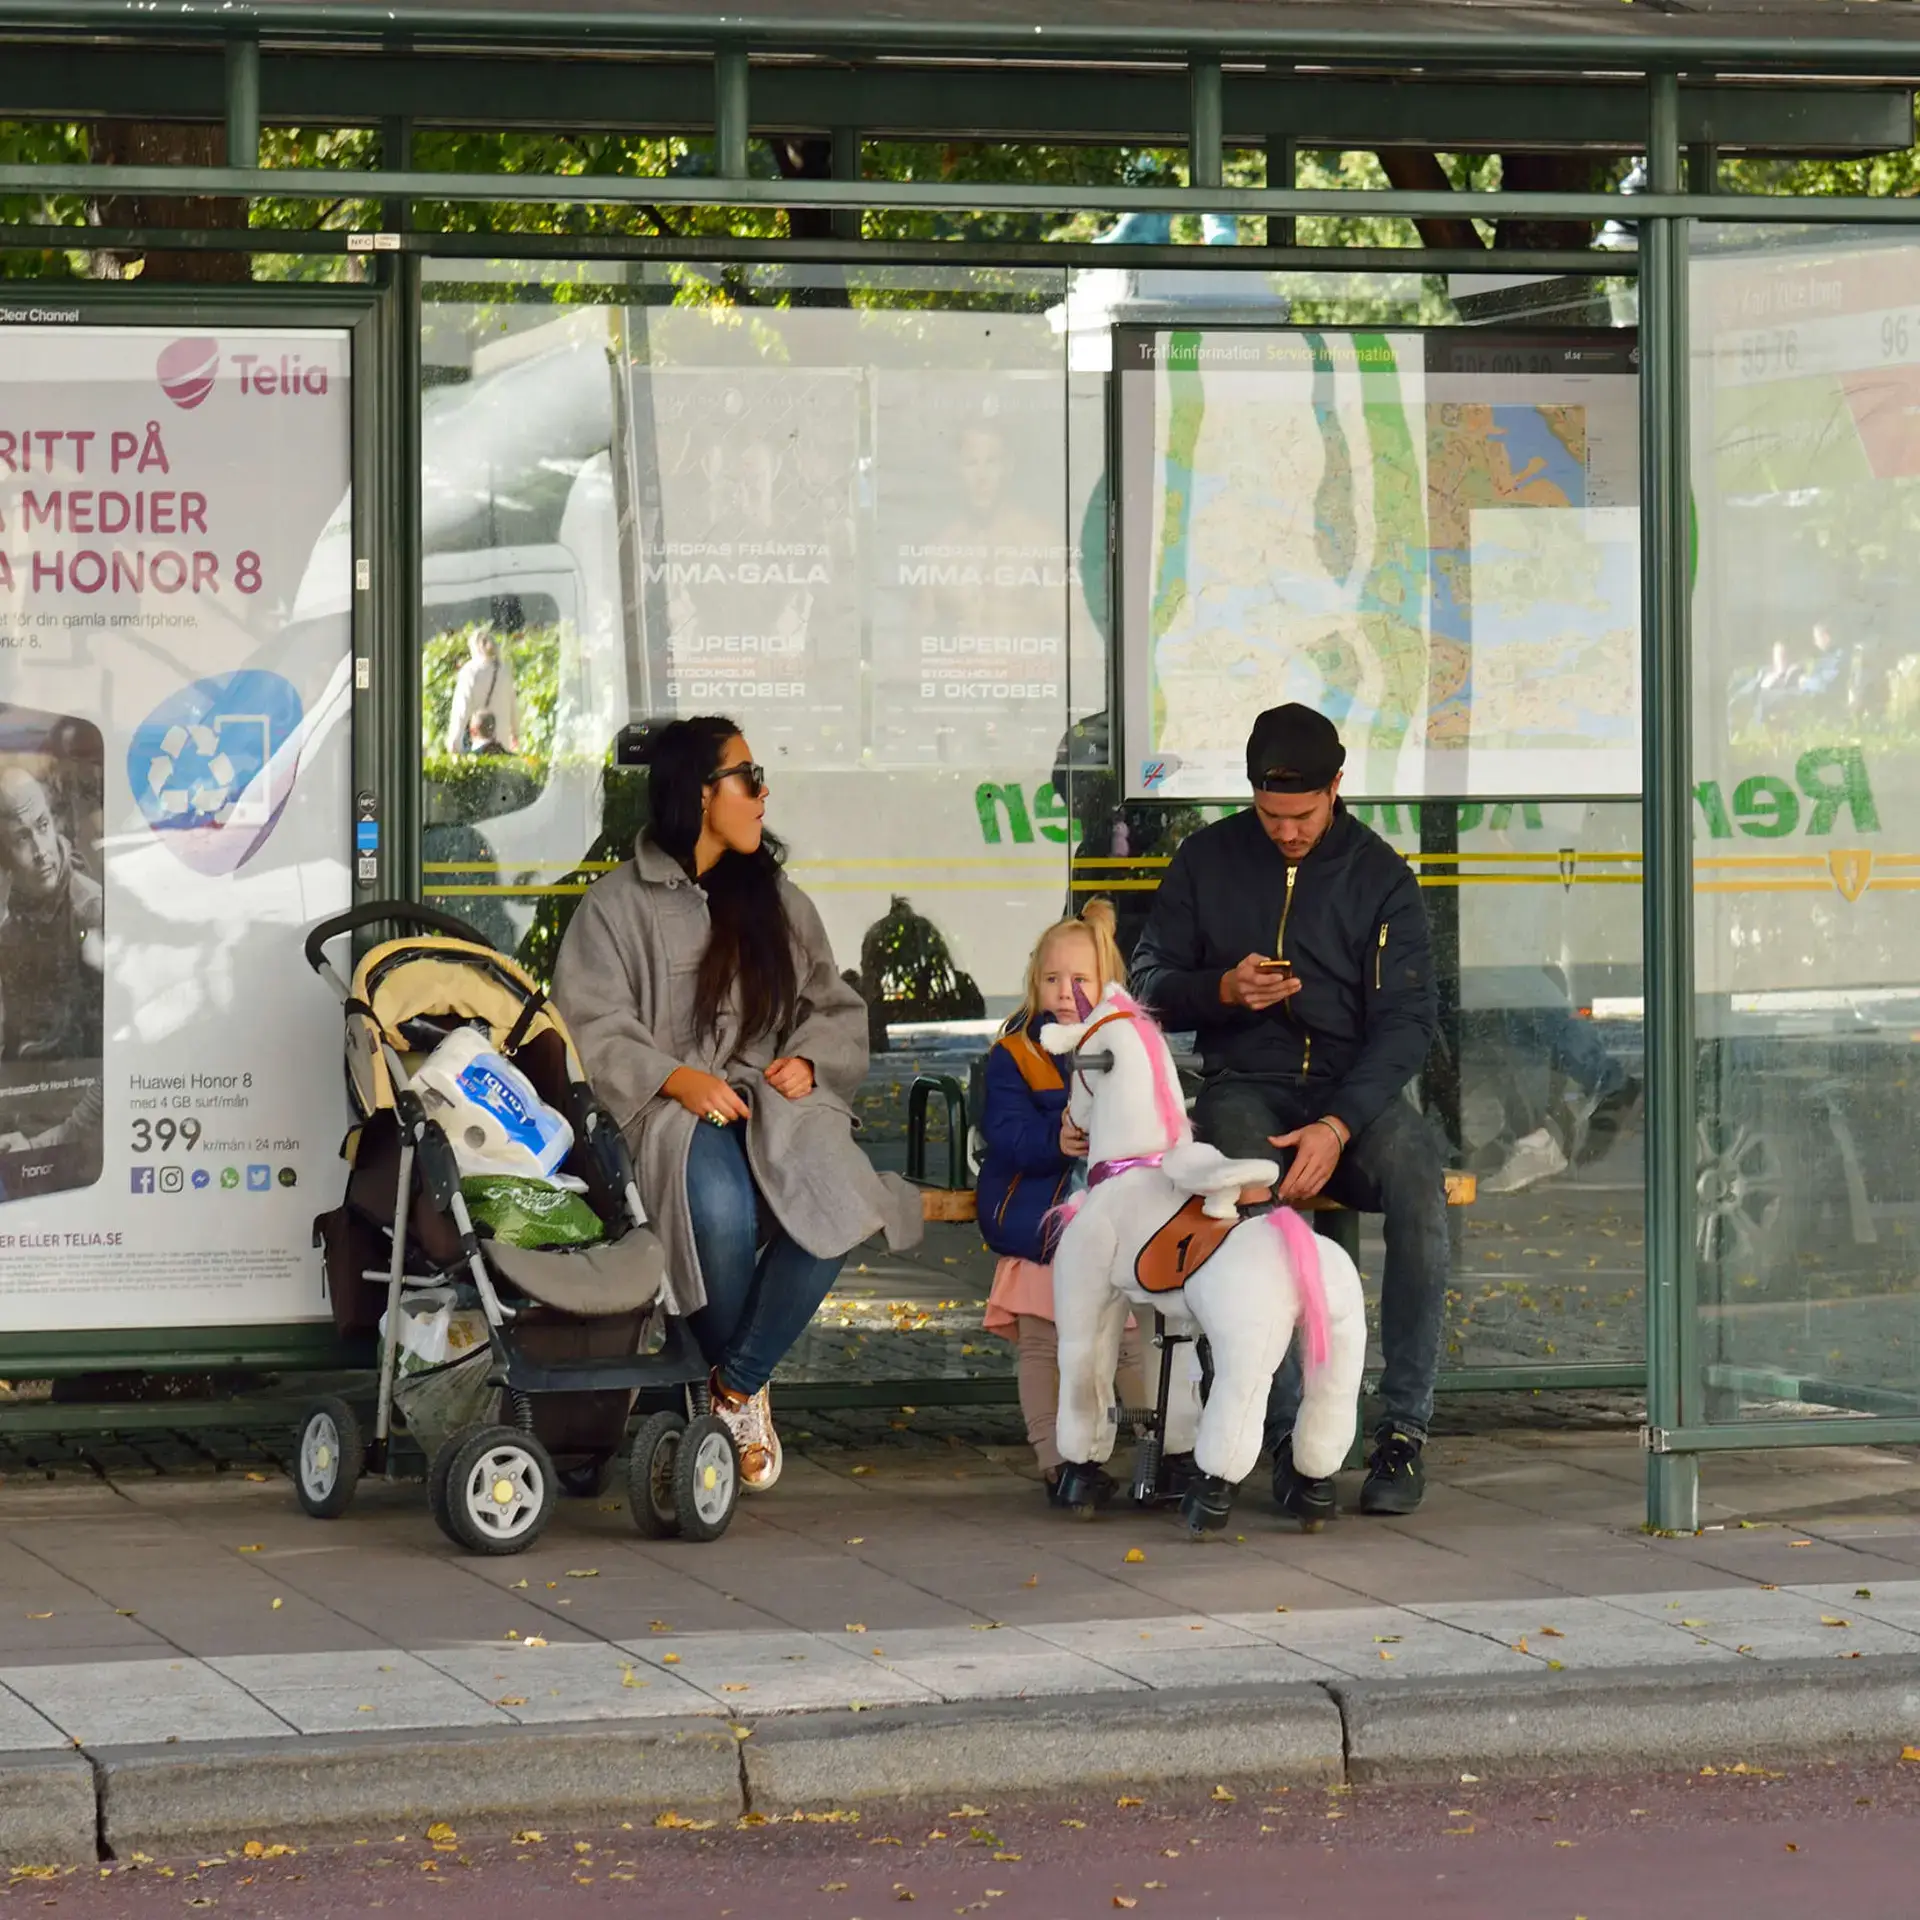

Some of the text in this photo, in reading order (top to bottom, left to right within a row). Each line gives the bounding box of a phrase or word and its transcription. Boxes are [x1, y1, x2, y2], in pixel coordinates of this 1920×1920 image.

[30, 308, 79, 322] Channel
[1881, 315, 1908, 358] 96
[1139, 344, 1260, 360] Trafikinformation
[1266, 344, 1316, 360] Service
[231, 354, 328, 395] Telia
[111, 420, 170, 474] PÅ
[21, 490, 208, 535] MEDIER
[32, 549, 219, 595] HONOR
[234, 549, 263, 594] 8
[36, 612, 58, 627] din
[63, 612, 106, 629] gamla
[110, 612, 199, 630] smartphone,
[666, 636, 805, 652] SUPERIOR
[920, 636, 1058, 654] SUPERIOR
[667, 682, 806, 698] 8 OKTOBER
[920, 682, 1058, 699] 8 OKTOBER
[130, 1072, 253, 1090] Huawei Honor 8
[130, 1093, 249, 1109] med 4 GB surf/mån
[131, 1117, 202, 1153] 399
[203, 1138, 245, 1151] kr/mån
[255, 1138, 269, 1151] 24
[274, 1138, 299, 1151] mån
[20, 1233, 60, 1248] ELLER
[64, 1232, 123, 1247] TELIA.SE
[1176, 1233, 1194, 1273] 1
